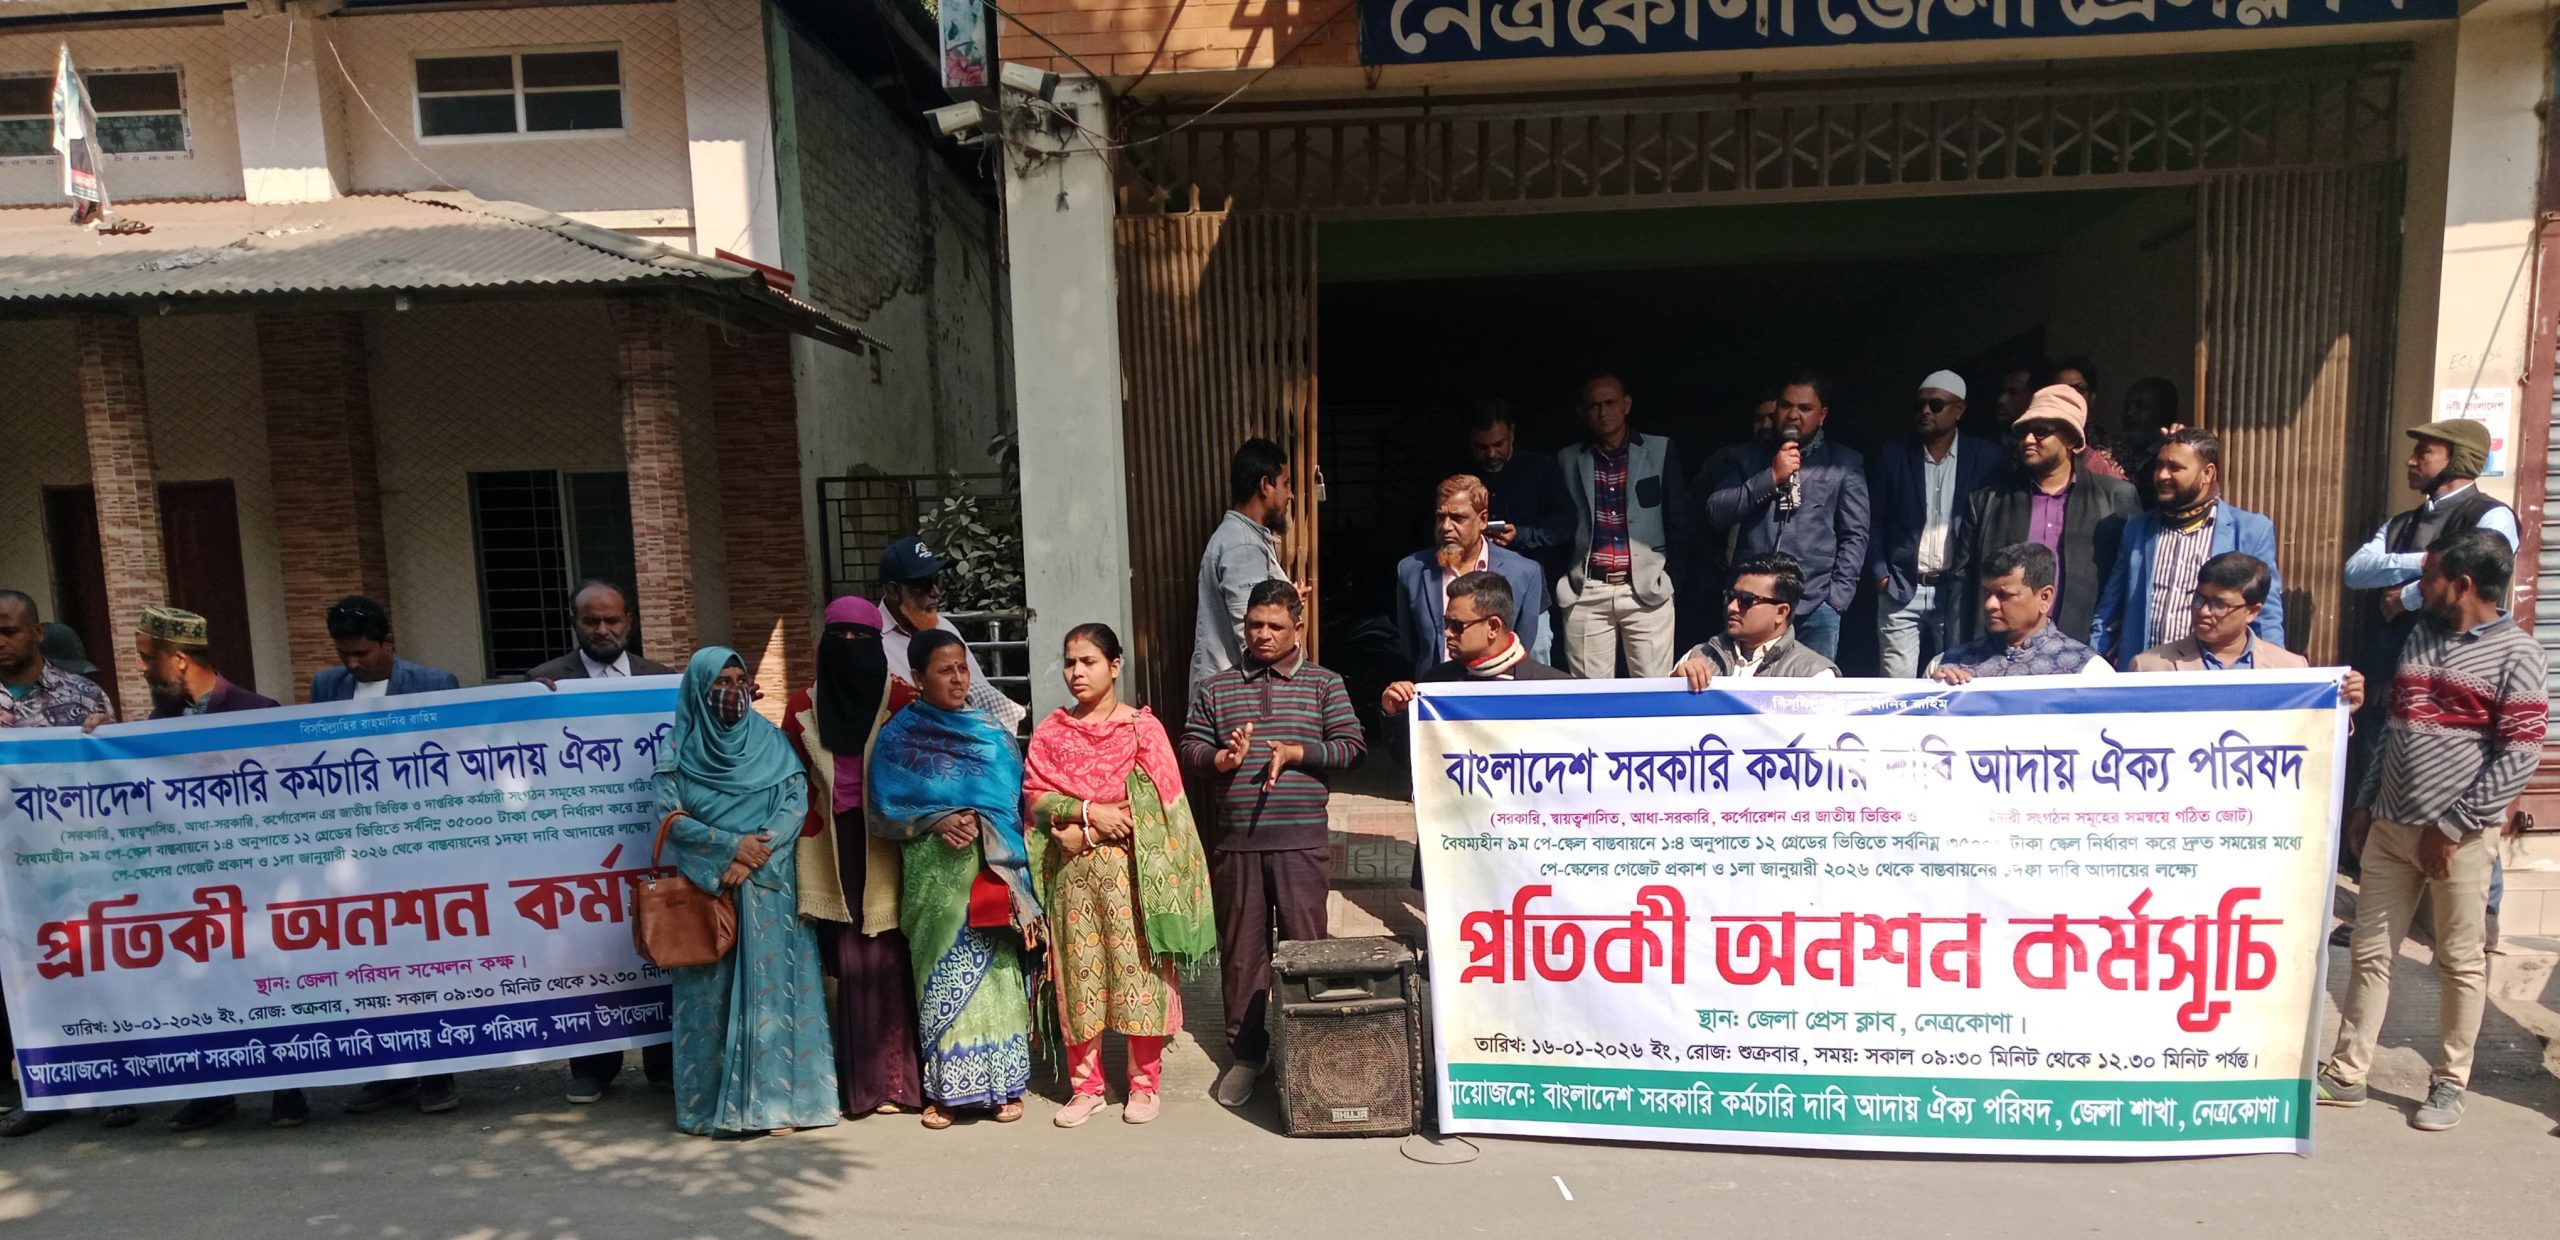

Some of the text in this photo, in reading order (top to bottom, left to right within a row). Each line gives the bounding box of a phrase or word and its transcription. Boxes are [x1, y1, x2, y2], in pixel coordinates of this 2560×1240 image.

[11, 777, 155, 822] বাংলাদেশ
[162, 759, 269, 808] সরকারি
[276, 748, 381, 801] কর্মচারি
[387, 741, 450, 789] দাবি
[457, 741, 549, 783] আদায়
[560, 726, 623, 774] ঐক্য
[1442, 747, 1599, 799] বাংলাদেশ
[1605, 733, 1735, 794] সরকারি
[1966, 745, 2080, 794] আদায়
[2092, 727, 2176, 793] ঐক্য
[2189, 729, 2309, 791] পরিষদ
[262, 809, 316, 826] কর্পোরেশন
[319, 809, 336, 821] এর
[339, 803, 372, 820] জাতীয়
[375, 798, 408, 816] ভিত্তিক
[412, 799, 421, 811] ও
[467, 790, 504, 807] কর্মচারী
[508, 786, 546, 803] সংগঠন
[549, 785, 586, 802] সমূহের
[1720, 807, 1787, 824] কর্পোরেশন
[1791, 810, 1811, 823] এর
[1815, 806, 1856, 824] জাতীয়
[1860, 806, 1902, 824] ভিত্তিক
[2026, 808, 2070, 825] সংগঠন
[2075, 811, 2120, 829] সমূহের
[2124, 811, 2170, 824] সমন্বয়ে
[2175, 806, 2211, 824] গঠিত
[15, 848, 74, 867] বৈষম্যহীন
[79, 850, 100, 863] ৯ম
[157, 839, 209, 856] বাস্তবায়নে
[238, 833, 290, 852] অনুপাতে
[294, 831, 311, 845] ১২
[314, 826, 352, 843] গ্রেডের
[356, 819, 400, 838] ভিত্তিতে
[445, 815, 493, 829] ৩৫০০০
[497, 808, 526, 825] টাকা
[530, 807, 558, 823] স্কেল
[562, 802, 604, 820] নির্ধারণ
[608, 801, 633, 815] করে
[176, 859, 214, 876] গেজেট
[218, 857, 254, 872] প্রকাশ
[258, 856, 268, 868] ও
[273, 853, 294, 868] ১লা
[299, 845, 346, 867] জানুয়ারী
[350, 846, 388, 862] ২০২৬
[392, 839, 423, 856] থেকে
[427, 834, 491, 853] বাস্তবায়নের
[532, 826, 560, 843] দাবি
[563, 823, 615, 840] আদায়ের
[1441, 832, 1504, 851] বৈষম্যহীন
[1507, 836, 1529, 851] ৯ম
[1533, 836, 1588, 851] পে-স্কেল
[1592, 836, 1656, 851] বাস্তবায়নে
[1690, 835, 1751, 854] অনুপাতে
[1755, 836, 1777, 852] ১২
[1781, 835, 1828, 852] গ্রেডের
[1833, 831, 1888, 851] ভিত্তিতে
[1892, 831, 1941, 852] সর্বনিম্ন
[2009, 833, 2045, 852] টাকা
[2050, 836, 2082, 852] স্কেল
[2087, 832, 2138, 851] নির্ধারণ
[2145, 836, 2177, 851] করে
[2182, 836, 2214, 853] দ্রুত
[2219, 836, 2268, 851] সময়ের
[2273, 836, 2304, 851] মধ্যে
[1540, 857, 2198, 880] পে-স্কেলের গেজেট প্রকাশ ও ১লা জানুয়ারী ২০২৬ থেকে বাস্তবায়নের দাবি আদায়ের লক্ষ্যে
[36, 882, 490, 980] প্রতিকী অনশন
[253, 957, 473, 996] স্থান: জেলা পরিষদ সম্মেলন
[1460, 884, 2284, 1033] প্রতিকী অনশন কর্মসূচি
[61, 1018, 108, 1038] তারিখ:
[112, 1011, 213, 1034] ১৬-০১-২০২৬
[248, 1004, 286, 1022] রোজ:
[353, 994, 392, 1011] সময়:
[395, 990, 438, 1007] সকাল
[443, 985, 495, 1002] ০৯:৩০
[500, 977, 543, 998] মিনিট
[547, 972, 585, 993] থেকে
[589, 971, 637, 989] ১২.৩০
[1695, 1008, 1739, 1032] স্থান:
[1747, 1008, 1799, 1031] জেলা
[1805, 1010, 1849, 1032] প্রেস
[25, 1009, 592, 1085] আয়োজনে: বাংলাদেশ সরকারি কর্মচারি দাবি আদায় ঐক্য পরিষদ, মদন
[1474, 1032, 1527, 1055] তারিখ:
[1531, 1037, 1644, 1060] ১৬-০১-২০২৬
[1686, 1043, 1731, 1062] রোজ:
[1814, 1046, 1859, 1065] সময়:
[1865, 1047, 1914, 1066] সকাল
[1921, 1050, 1983, 1067] ০৯:৩০
[1989, 1045, 2040, 1068] মিনিট
[2046, 1050, 2092, 1070] থেকে
[2098, 1052, 2156, 1072] ১২.৩০
[2163, 1047, 2211, 1070] মিনিট
[1331, 1110, 1368, 1120] AHUJA
[1541, 1080, 2186, 1133] বাংলাদেশ সরকারি কর্মচারি দাবি আদায় ঐক্য পরিষদ, জেলা শাখা,
